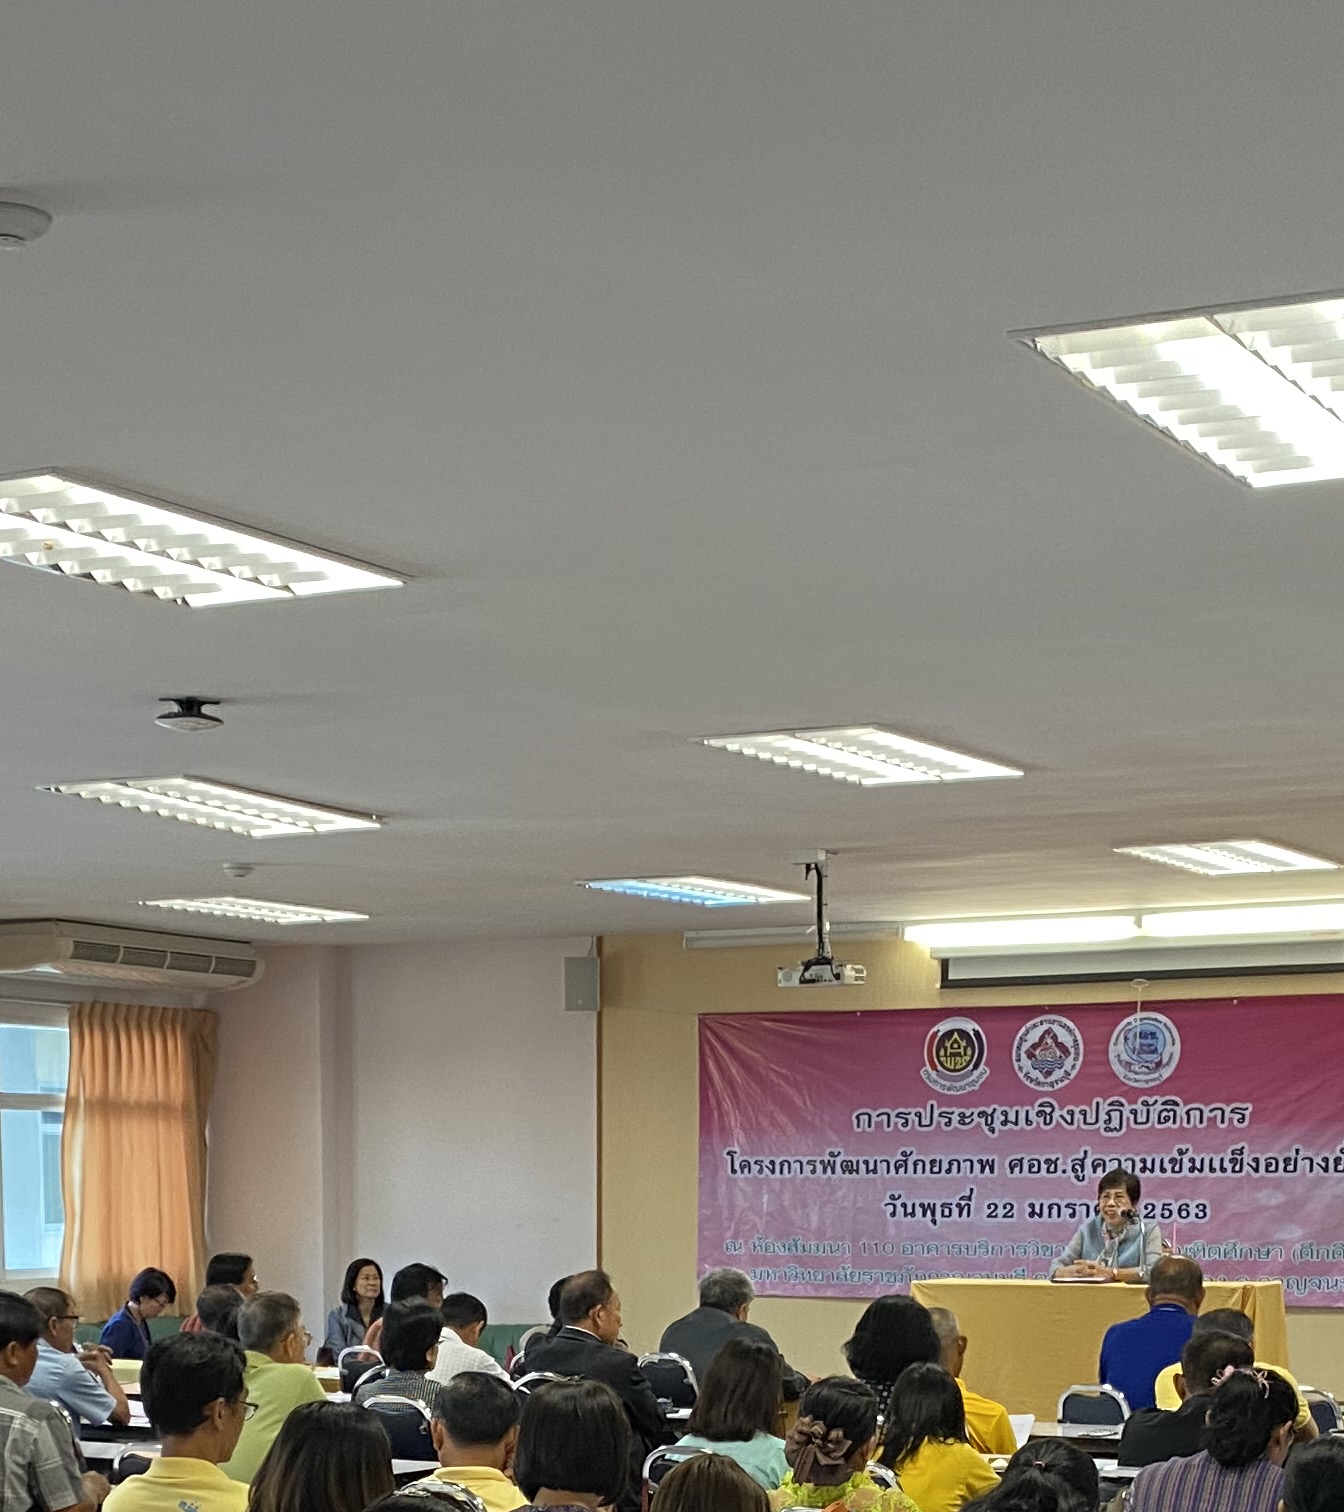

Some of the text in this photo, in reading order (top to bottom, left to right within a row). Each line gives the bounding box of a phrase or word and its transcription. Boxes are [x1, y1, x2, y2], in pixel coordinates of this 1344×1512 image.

[854, 1099, 1250, 1134] การประชุมเชิงปฏิบัติการ
[727, 1150, 996, 1176] โครงการพัฒนาศักยภาพ
[884, 1188, 1208, 1226] วันพุธที่ 22 มกรา 2563
[752, 1237, 851, 1256] ห้องสัมมนา
[860, 1240, 895, 1256] 110
